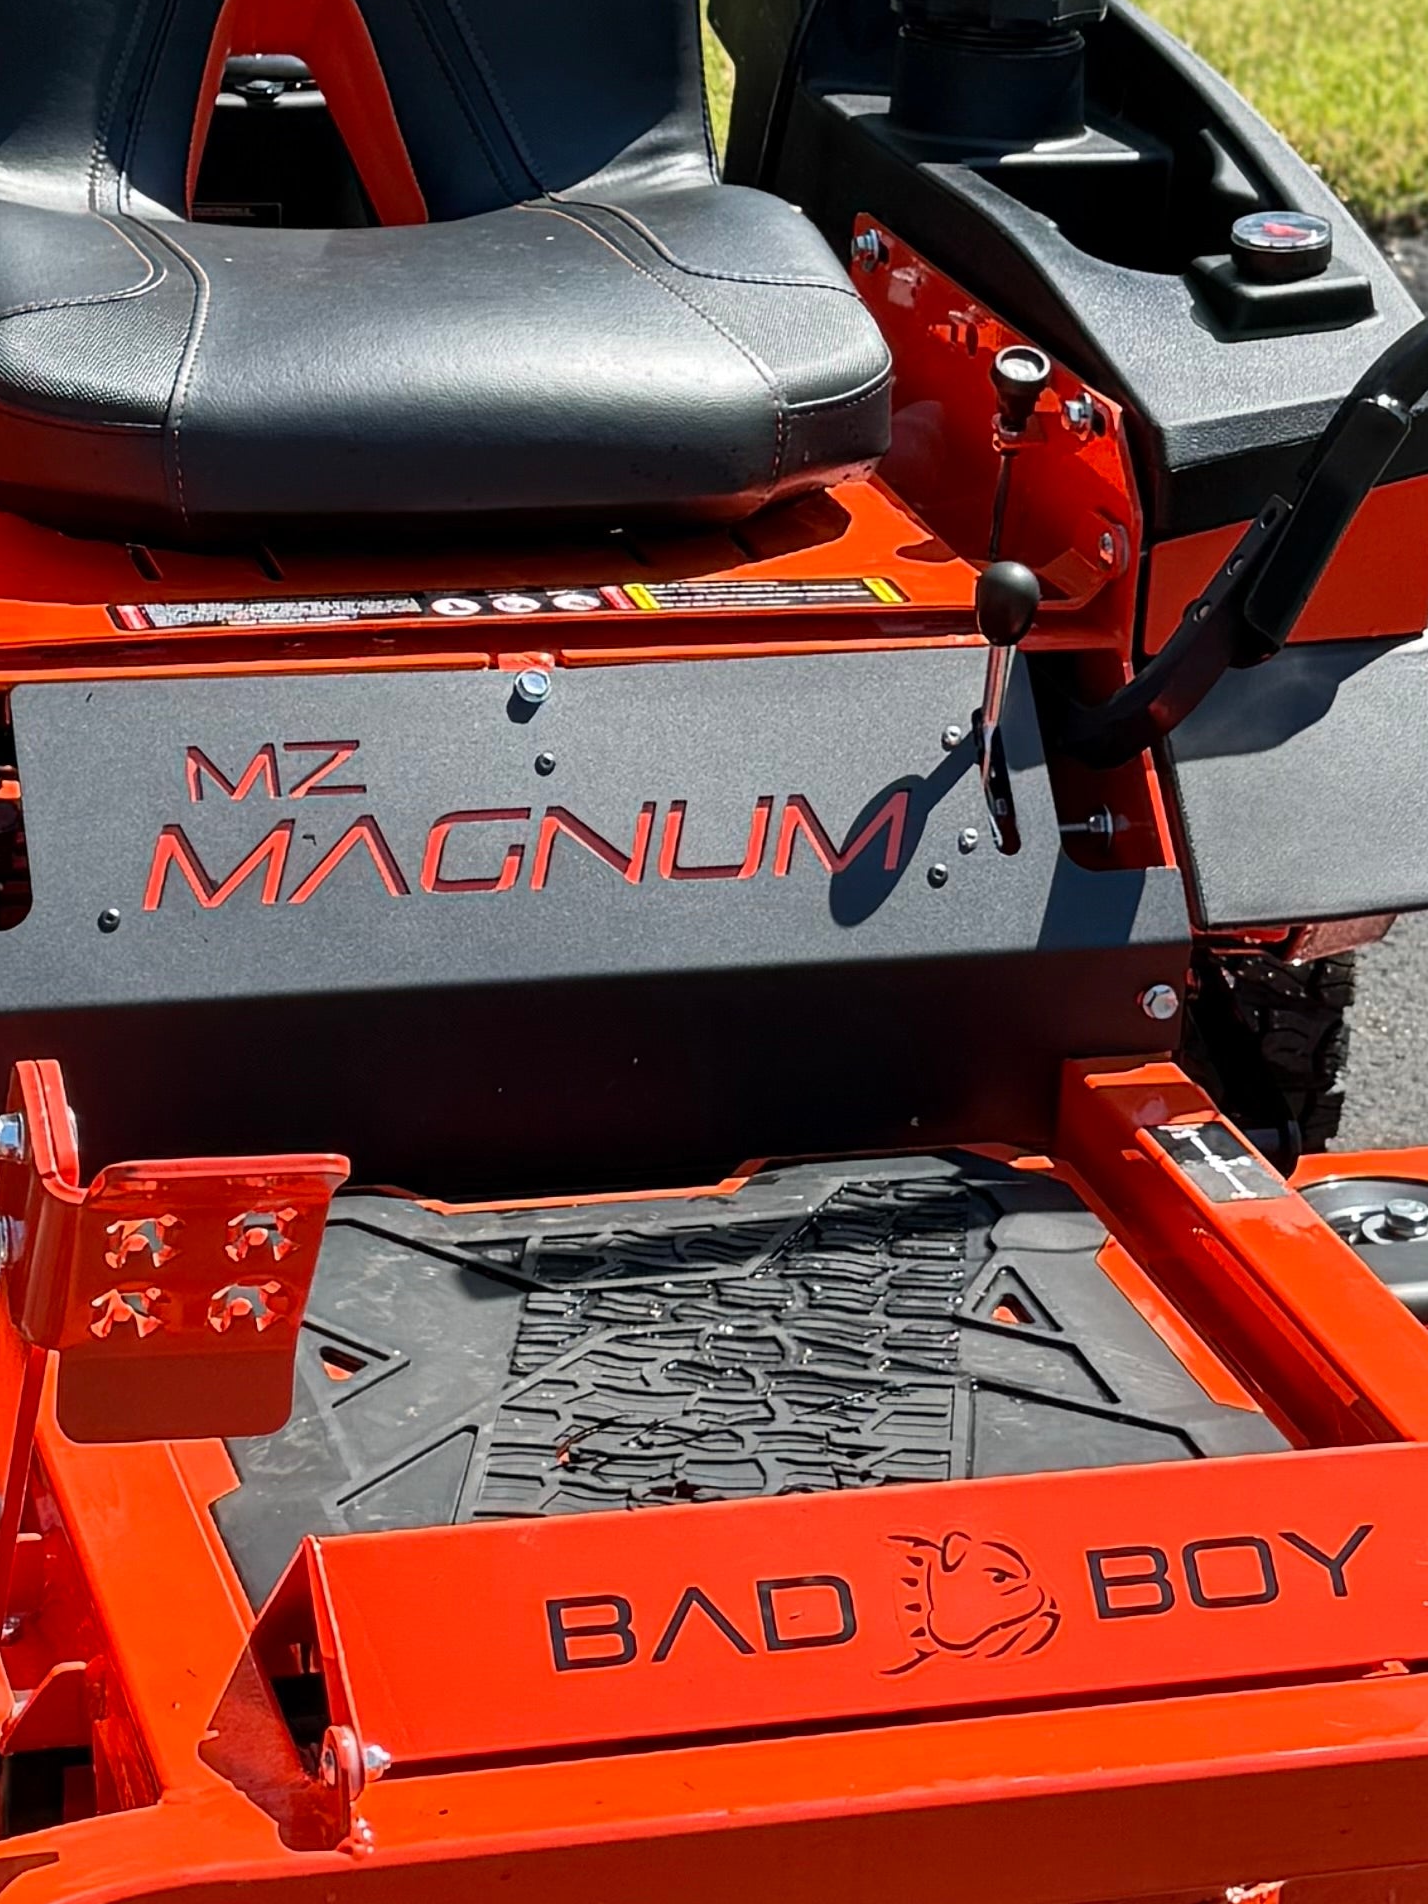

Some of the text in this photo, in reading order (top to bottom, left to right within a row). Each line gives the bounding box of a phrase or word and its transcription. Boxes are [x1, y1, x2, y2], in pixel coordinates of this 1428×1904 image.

[185, 739, 368, 803] MZ
[143, 788, 912, 912] MAGNUM
[545, 1524, 1375, 1673] BAD BOY
